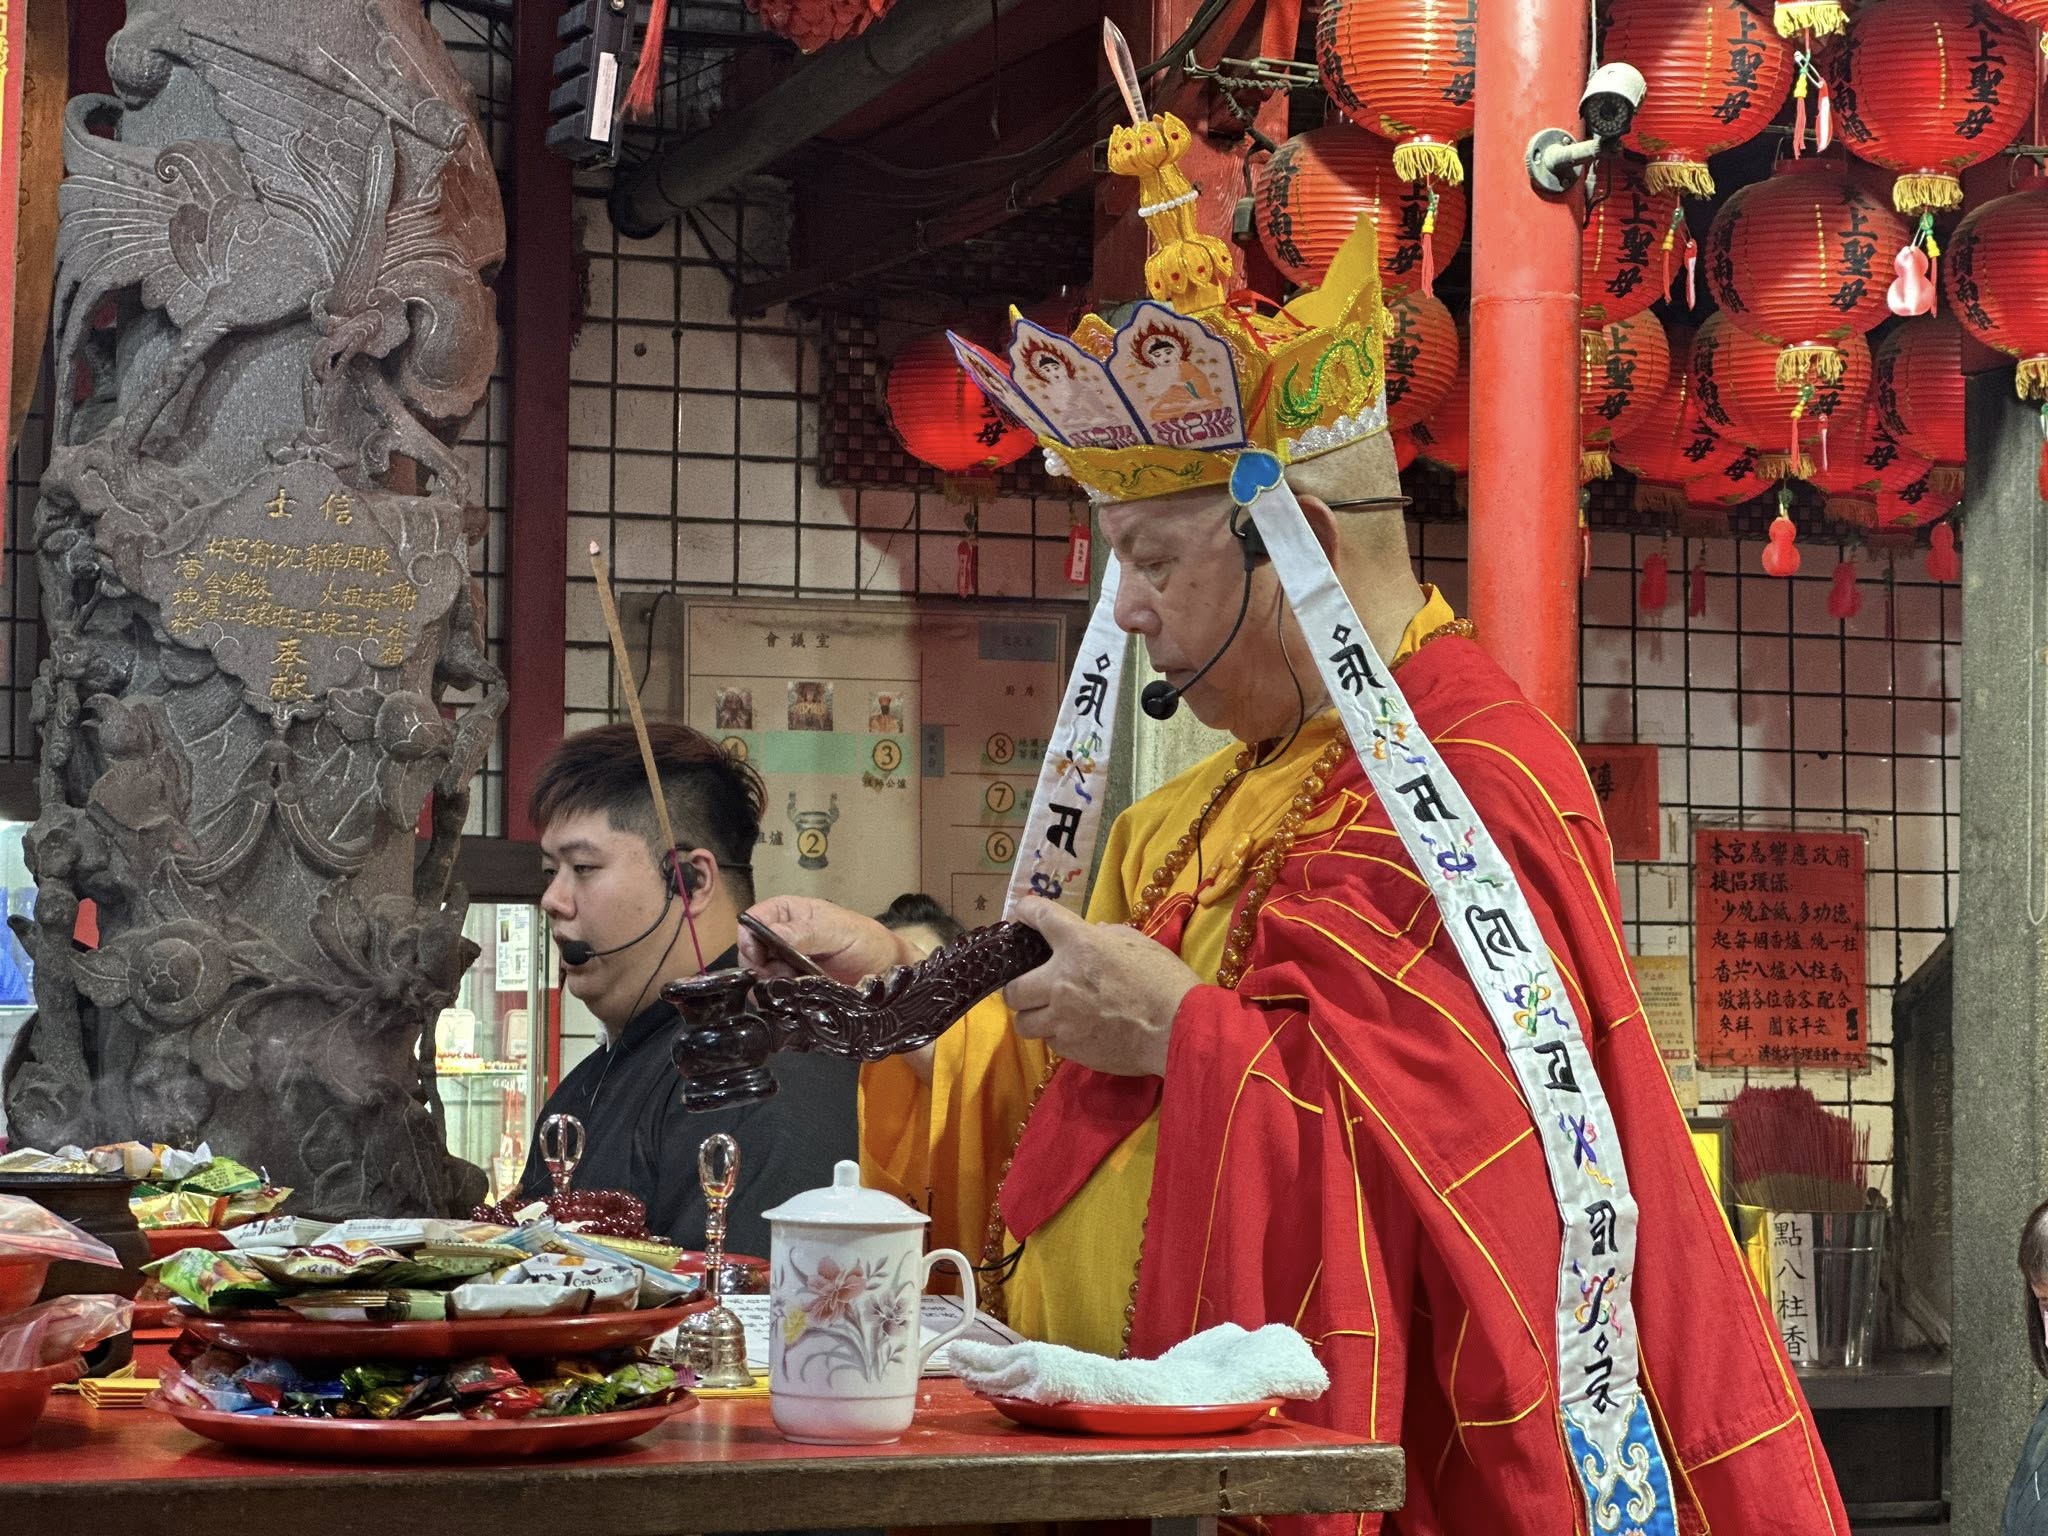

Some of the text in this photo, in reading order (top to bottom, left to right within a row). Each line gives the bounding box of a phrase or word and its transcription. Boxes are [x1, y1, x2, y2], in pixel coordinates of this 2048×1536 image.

[1828, 182, 1878, 312] 天上聖母
[764, 631, 830, 649] 會議室
[572, 1274, 614, 1289] Cracker
[1773, 1220, 1808, 1357] 點八柱香
